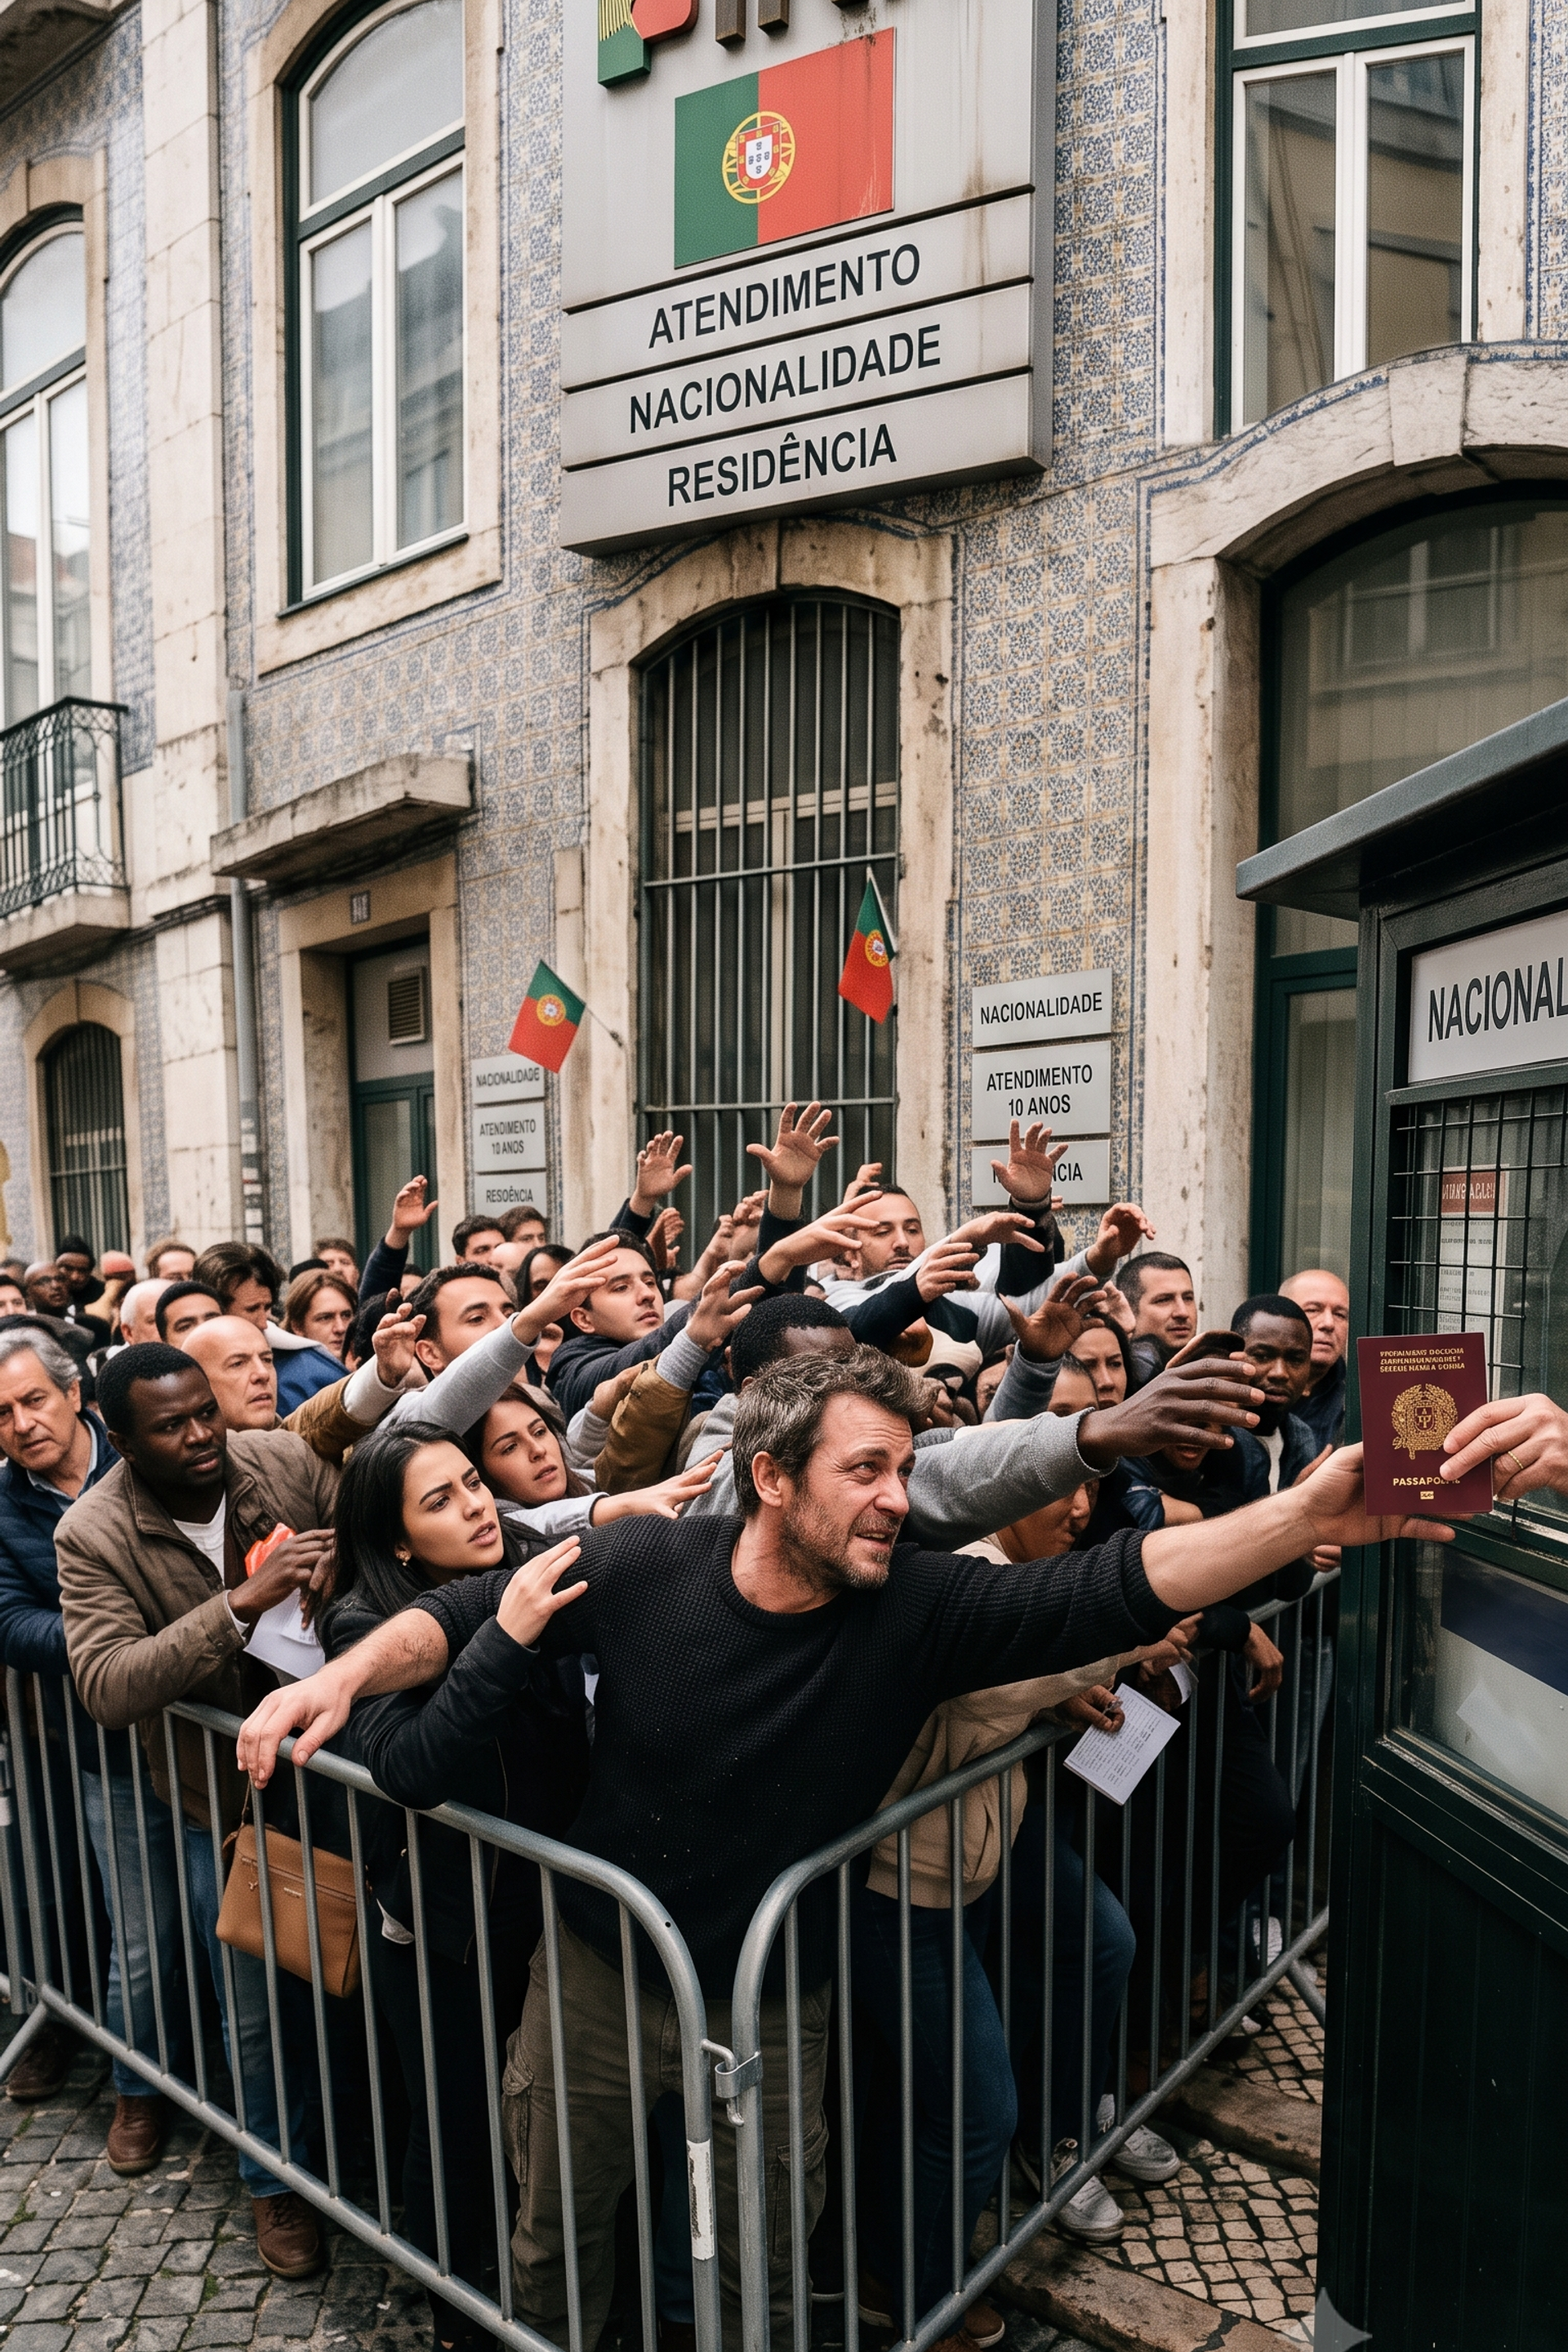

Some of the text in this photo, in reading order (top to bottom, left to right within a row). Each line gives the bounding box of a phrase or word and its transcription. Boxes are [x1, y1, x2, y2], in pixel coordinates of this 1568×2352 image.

[648, 244, 920, 349] ATENDIMENTO
[630, 324, 942, 434] NACIONALIDADE
[668, 424, 898, 507] RESIDÊNCIA
[981, 991, 1102, 1025] NACIONALIDADE
[1428, 957, 1568, 1042] NACIONAL
[987, 1064, 1093, 1091] ATENDIMENTO
[1009, 1094, 1071, 1116] 10 ANOS
[479, 1119, 536, 1137] ATENDIMENTO
[492, 1140, 524, 1155] 10 ANOS
[1393, 1477, 1460, 1486] PASSAPO
